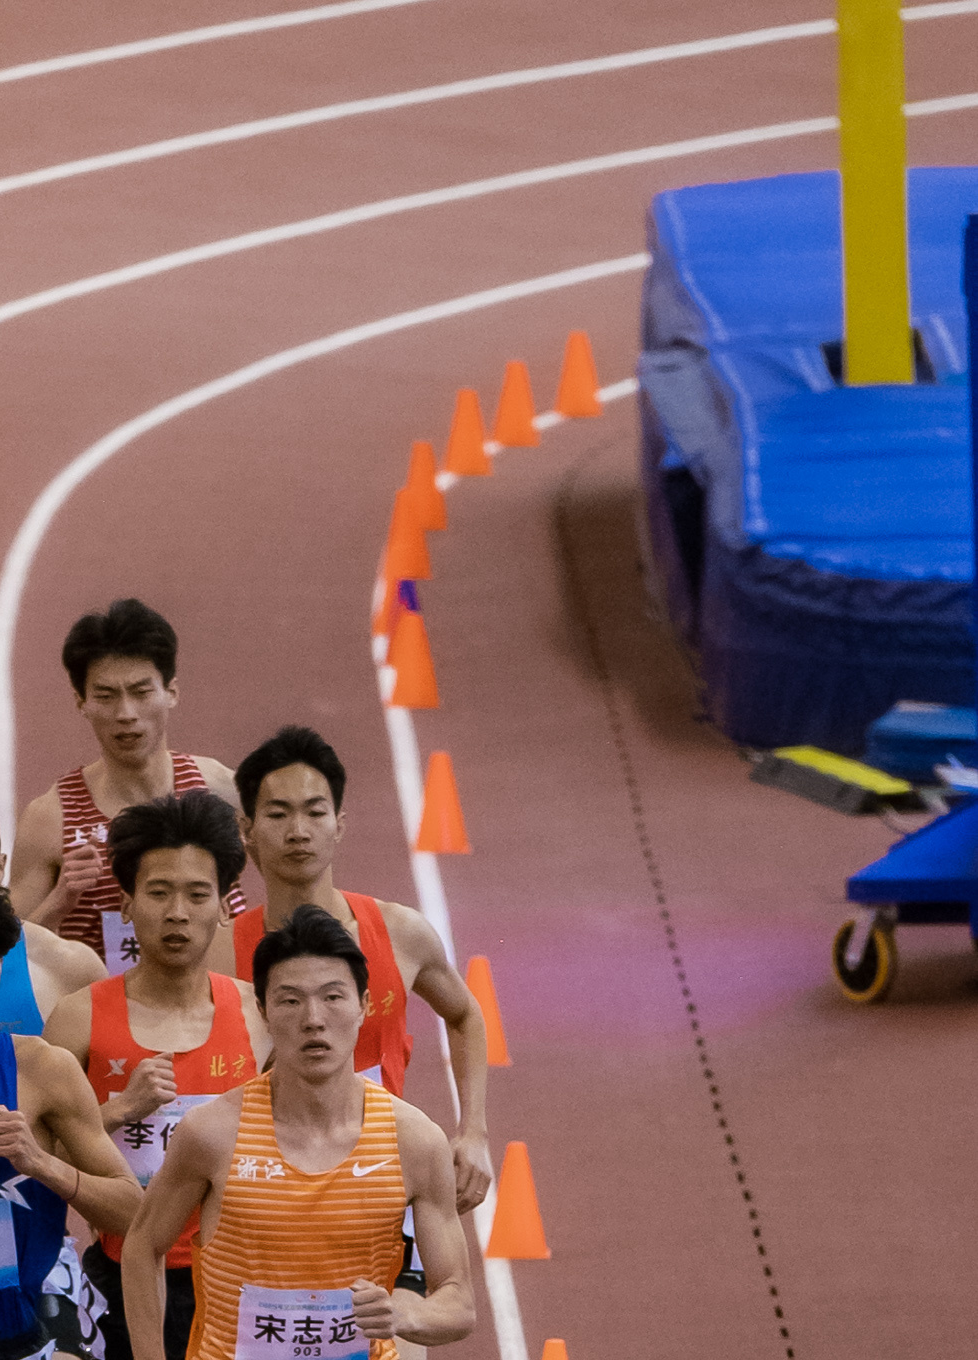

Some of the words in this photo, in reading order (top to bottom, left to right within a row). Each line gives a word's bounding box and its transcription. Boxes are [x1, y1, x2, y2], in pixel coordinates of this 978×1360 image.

[209, 1054, 247, 1079] 北京
[237, 1157, 286, 1181] 浙江
[254, 1314, 357, 1345] 宋志远
[293, 1347, 322, 1357] 903
